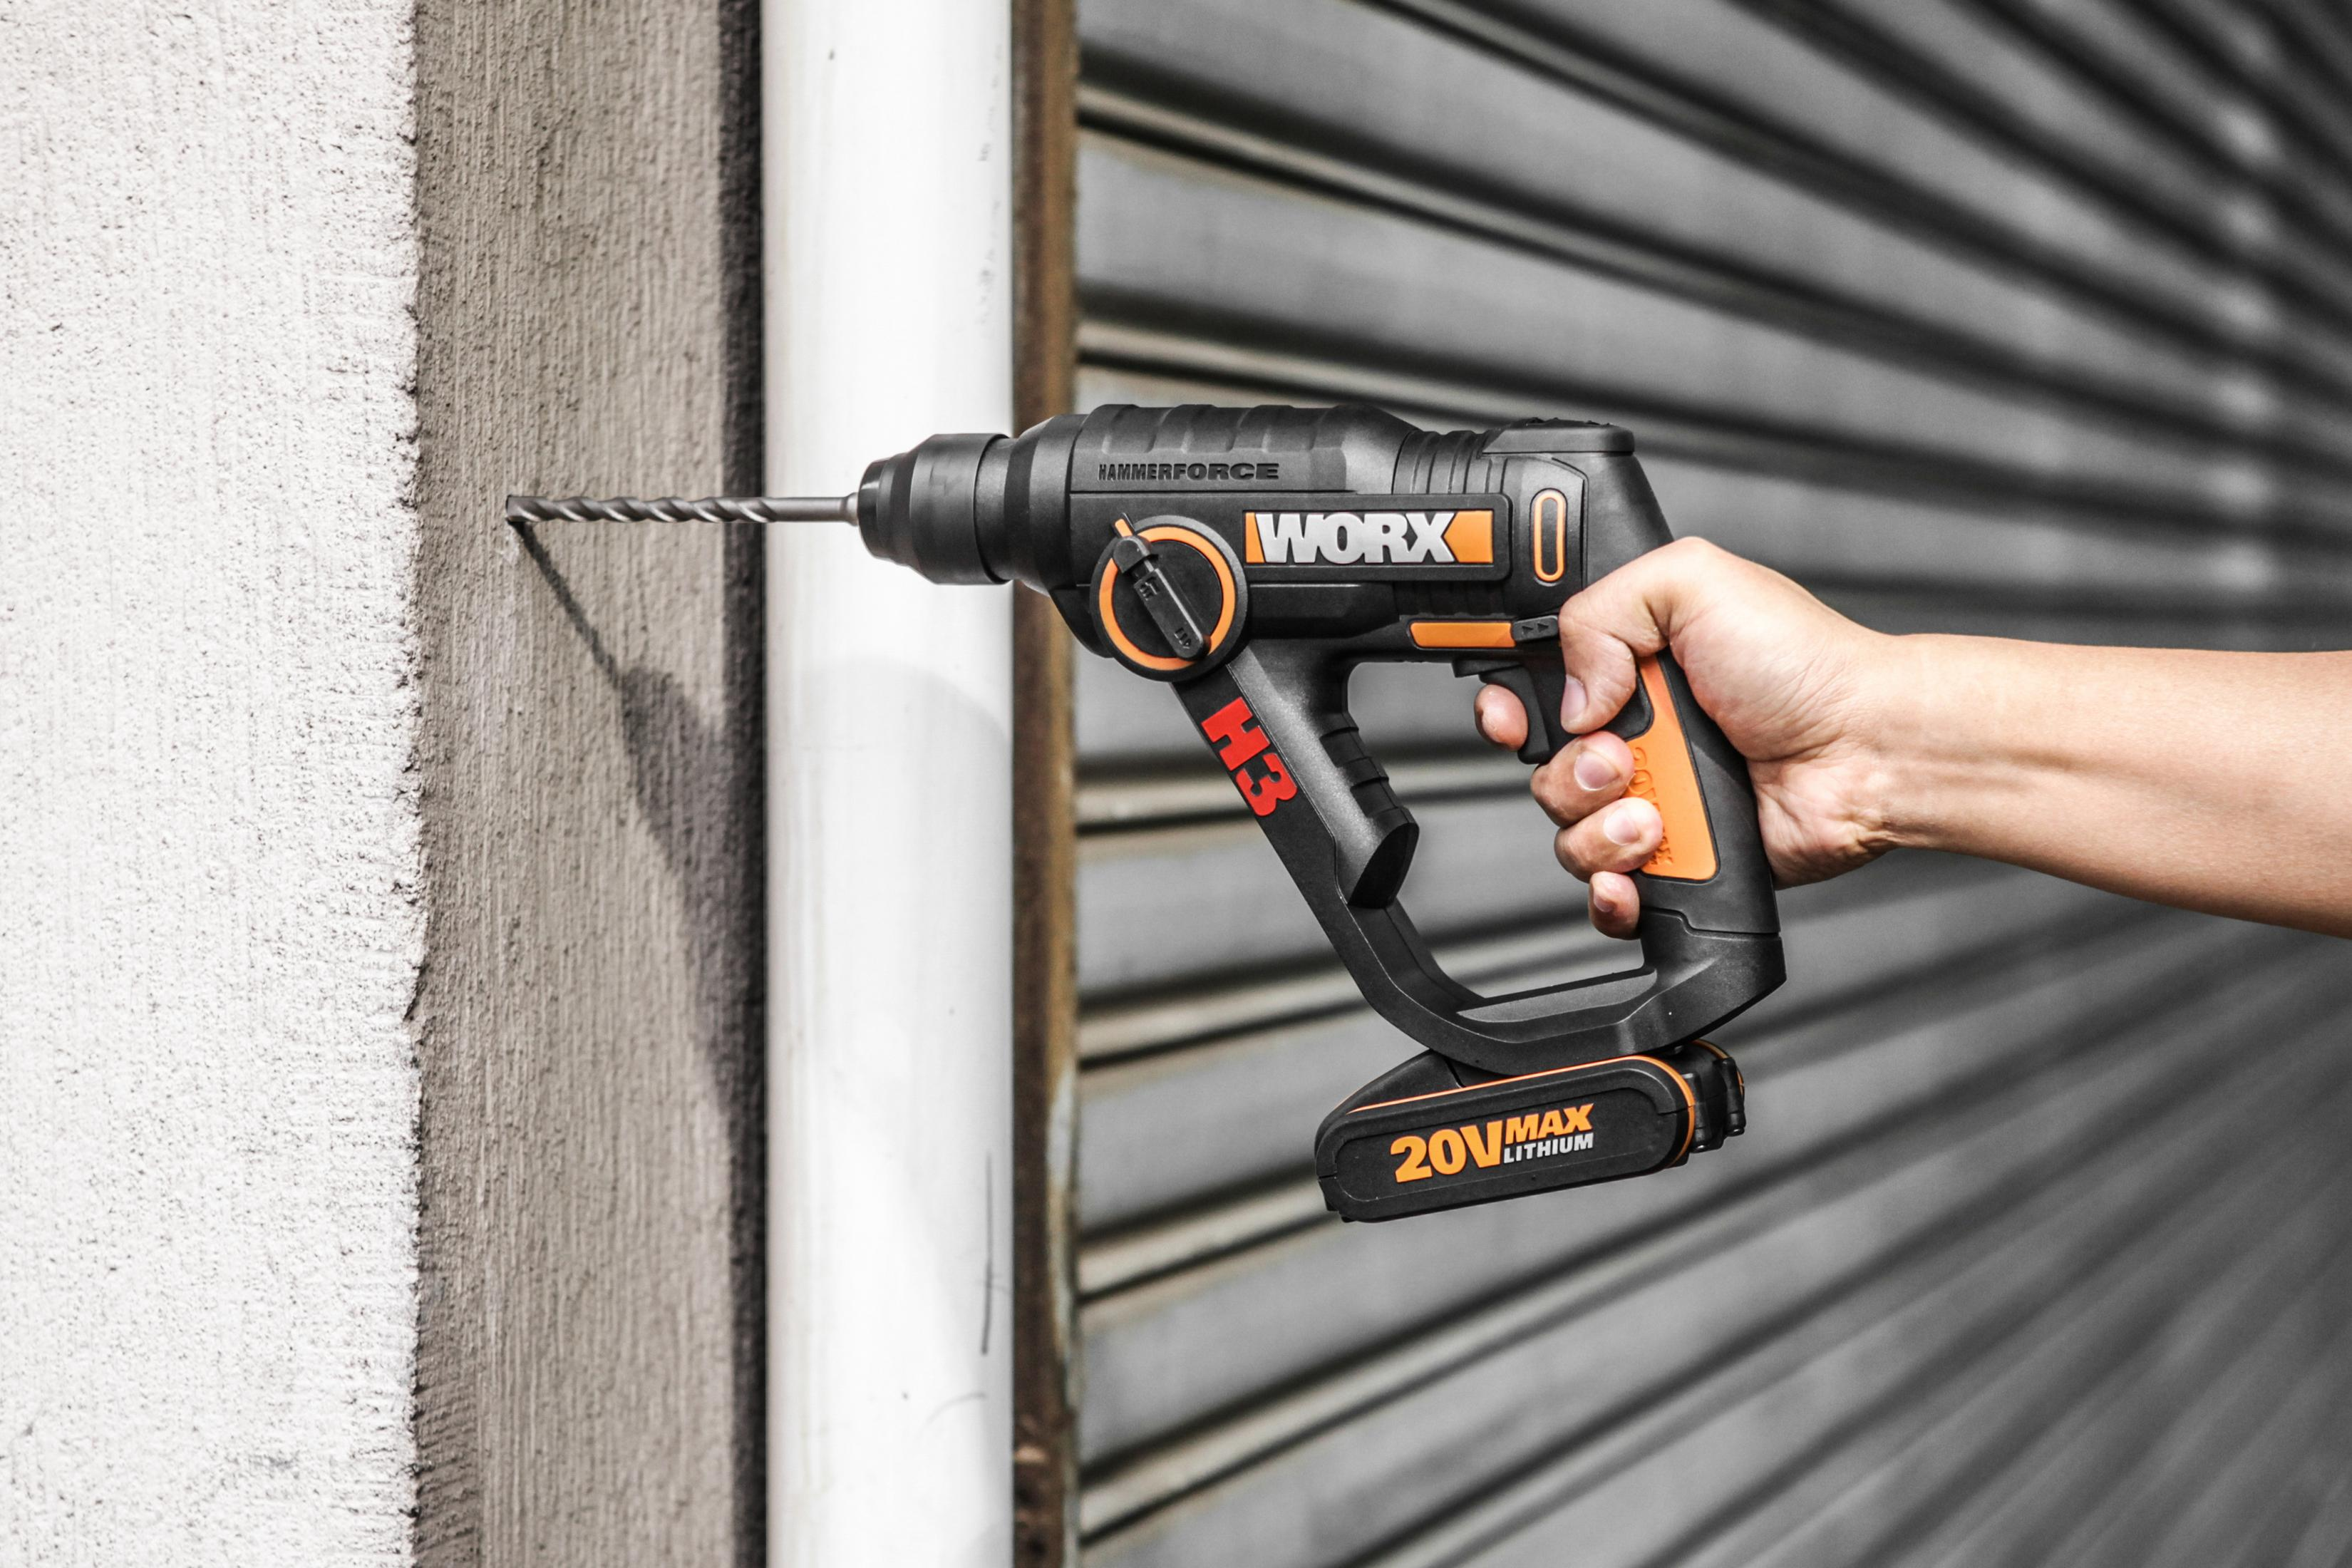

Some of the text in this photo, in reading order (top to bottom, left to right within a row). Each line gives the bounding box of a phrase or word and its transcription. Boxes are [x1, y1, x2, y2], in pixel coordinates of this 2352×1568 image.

[1098, 463, 1280, 480] HAMMERFORCE
[1255, 512, 1455, 564] WORX
[1201, 697, 1298, 817] H3
[1390, 1103, 1594, 1183] 20V MAX
[1503, 1132, 1594, 1165] LITHIUM
